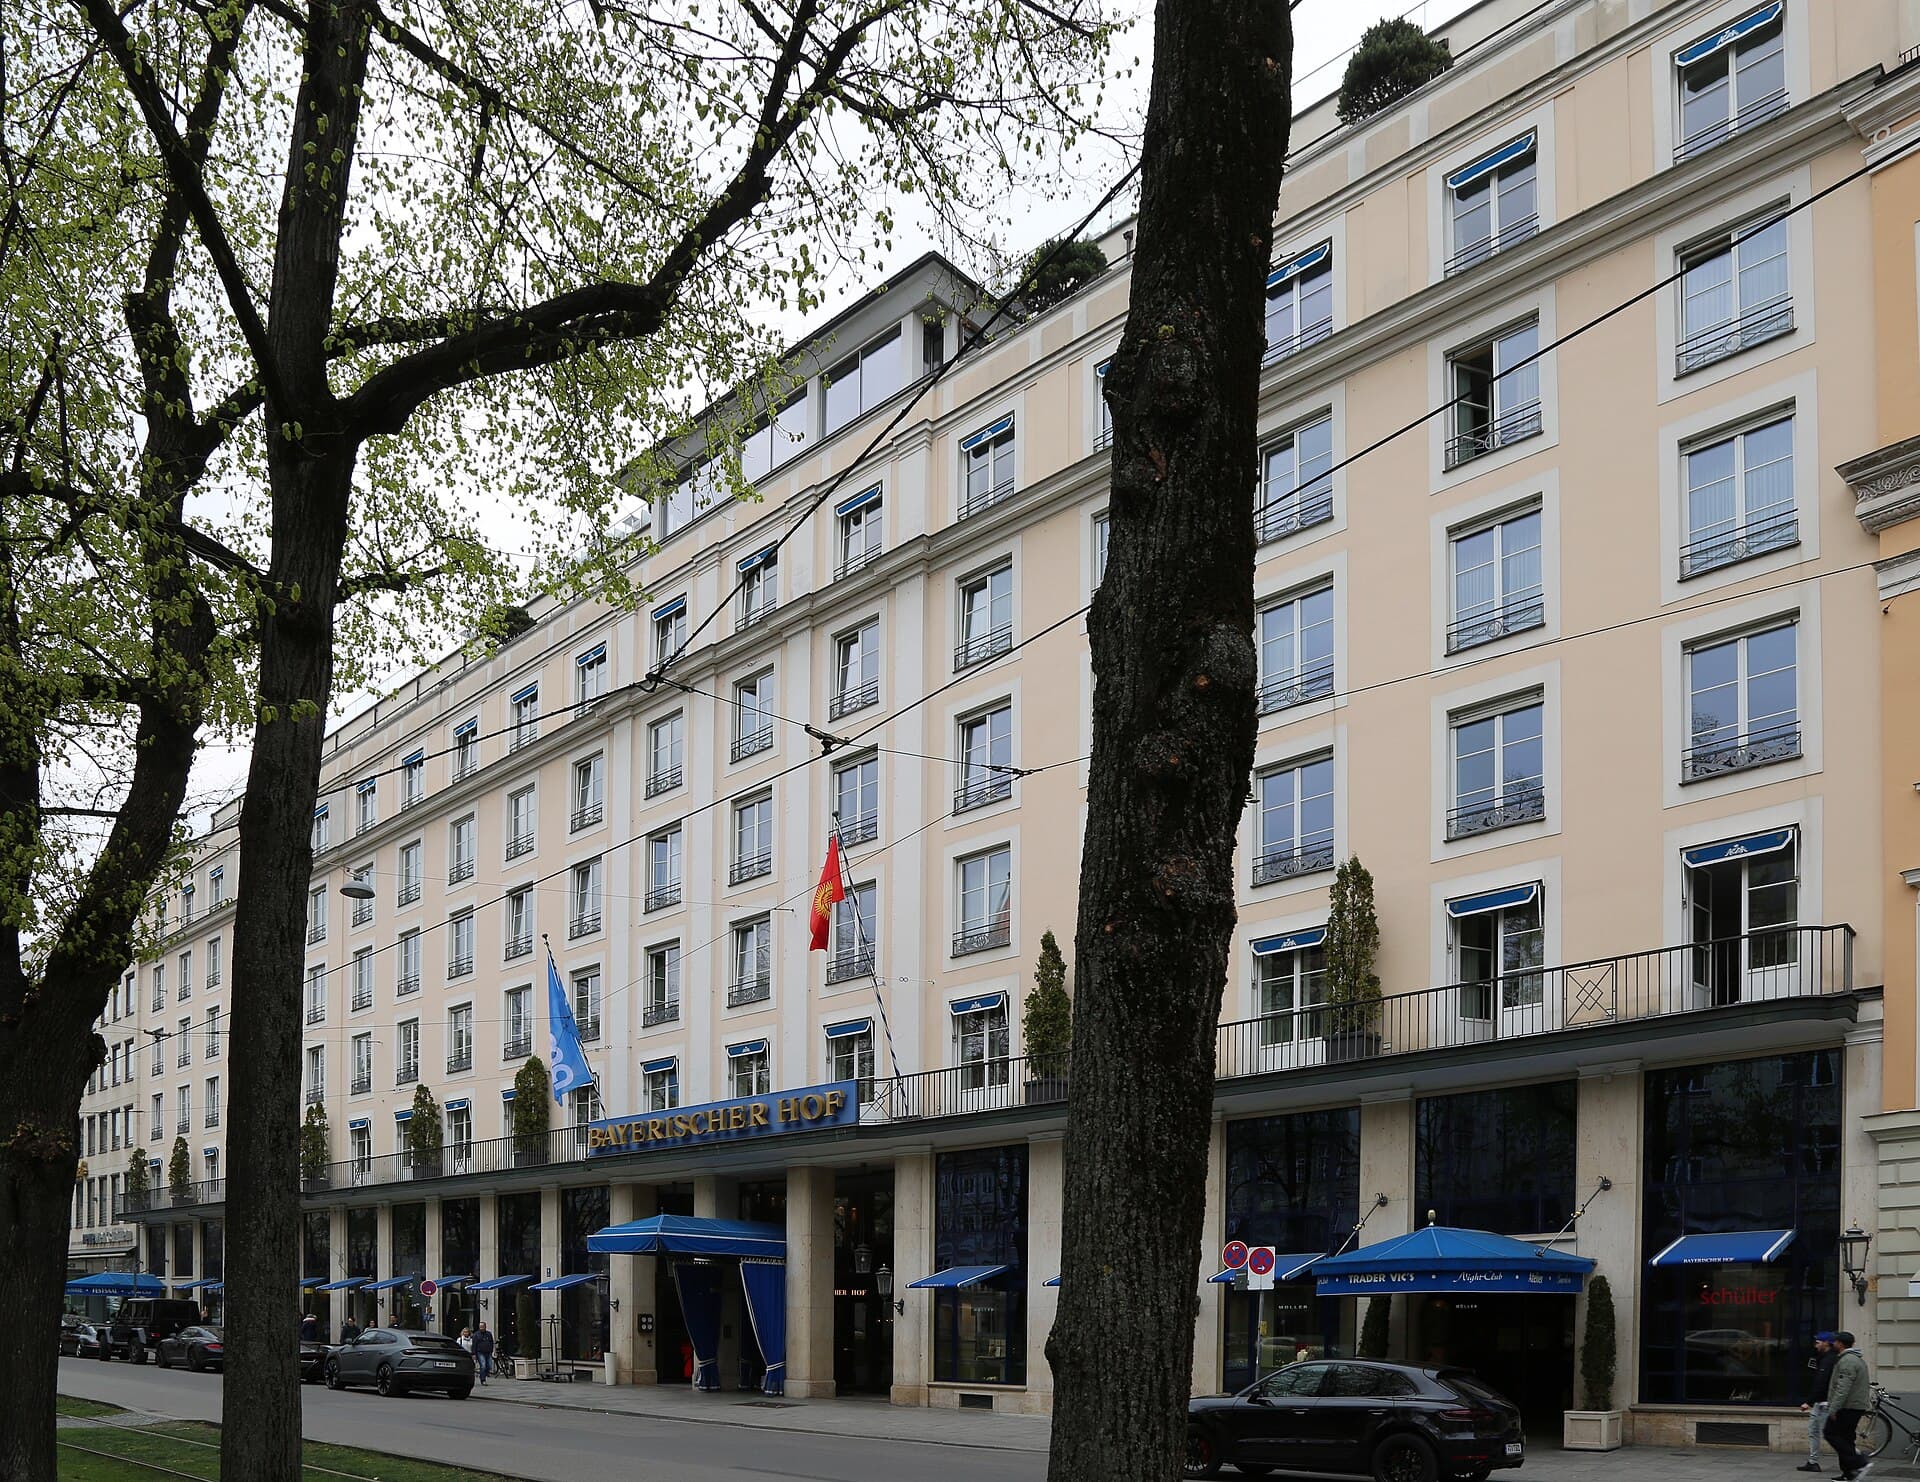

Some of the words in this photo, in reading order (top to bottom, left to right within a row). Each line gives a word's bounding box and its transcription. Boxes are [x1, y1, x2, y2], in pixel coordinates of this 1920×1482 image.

[589, 1102, 769, 1149] BAYERISCHER
[777, 1090, 847, 1123] HOF
[1348, 1273, 1386, 1284] TRADER
[1390, 1272, 1415, 1283] VIC'S
[1700, 1287, 1777, 1305] schüller
